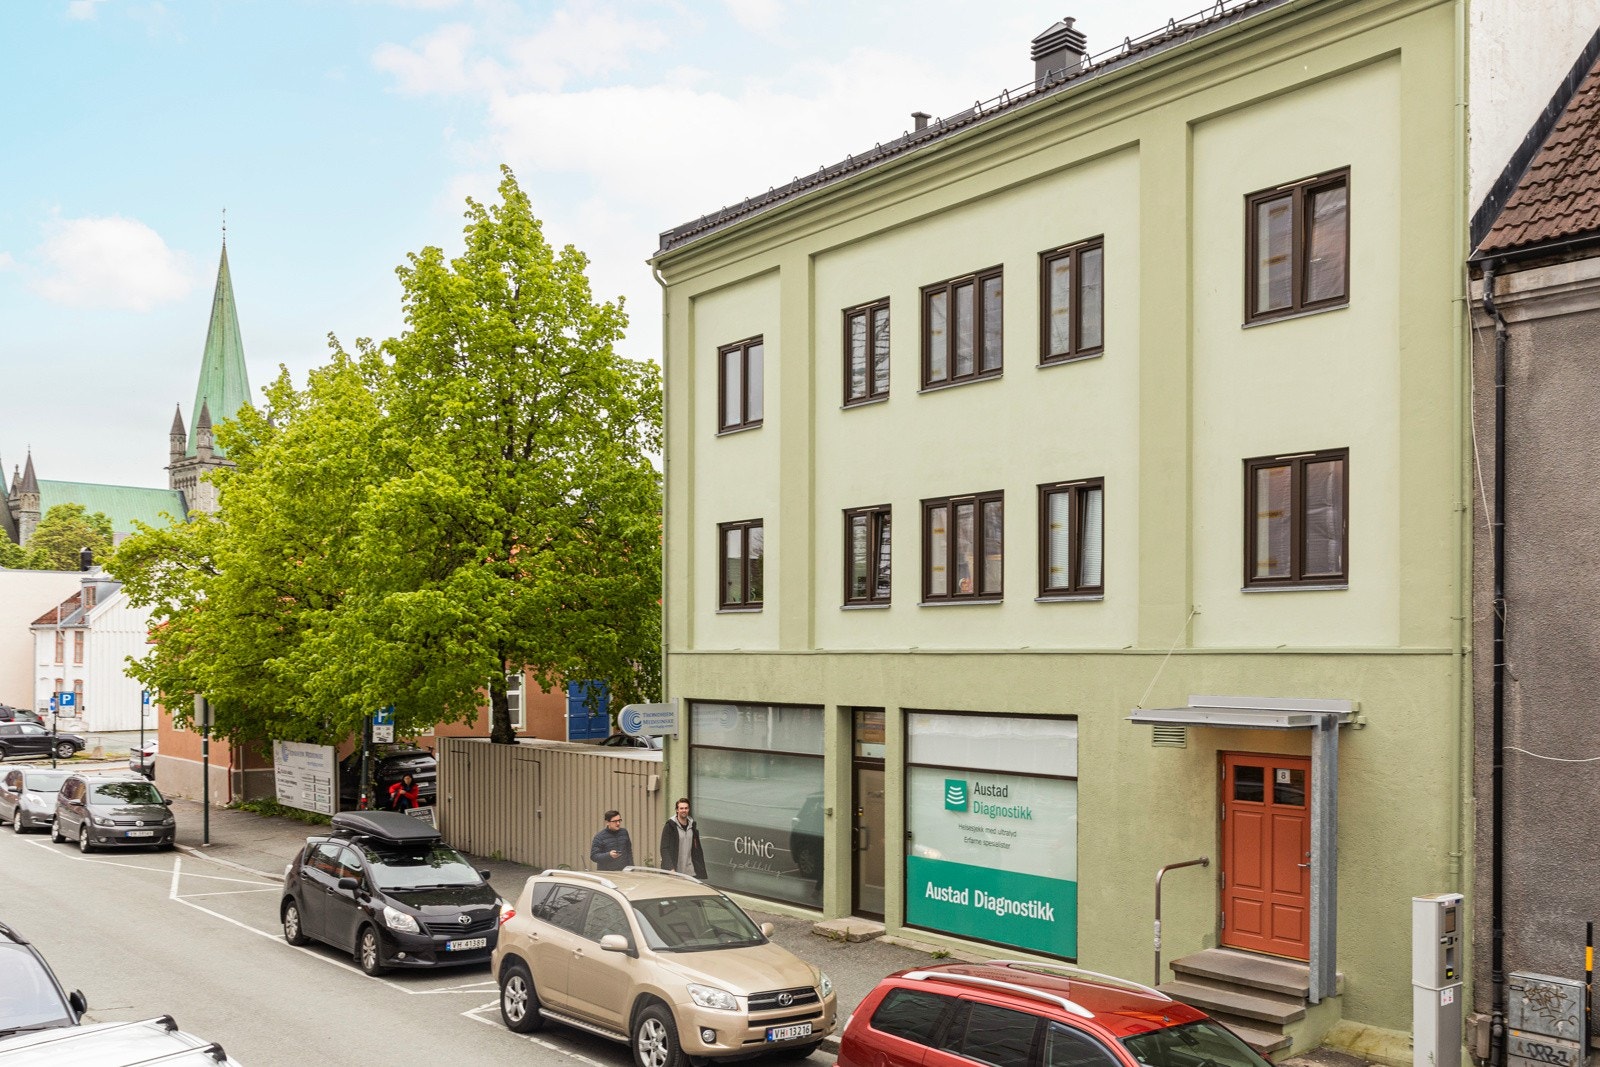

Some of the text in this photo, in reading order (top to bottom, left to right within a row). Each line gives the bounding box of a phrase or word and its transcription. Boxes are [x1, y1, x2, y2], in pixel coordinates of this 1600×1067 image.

[62, 694, 72, 705] P
[1281, 772, 1286, 780] 8
[973, 782, 1008, 799] Austad
[973, 801, 1033, 820] Diagnostikk
[958, 824, 1017, 838] Helsesjekk med ultralyd
[925, 881, 1055, 922] Austad Diagnostikk
[774, 1025, 810, 1039] VH 13216
